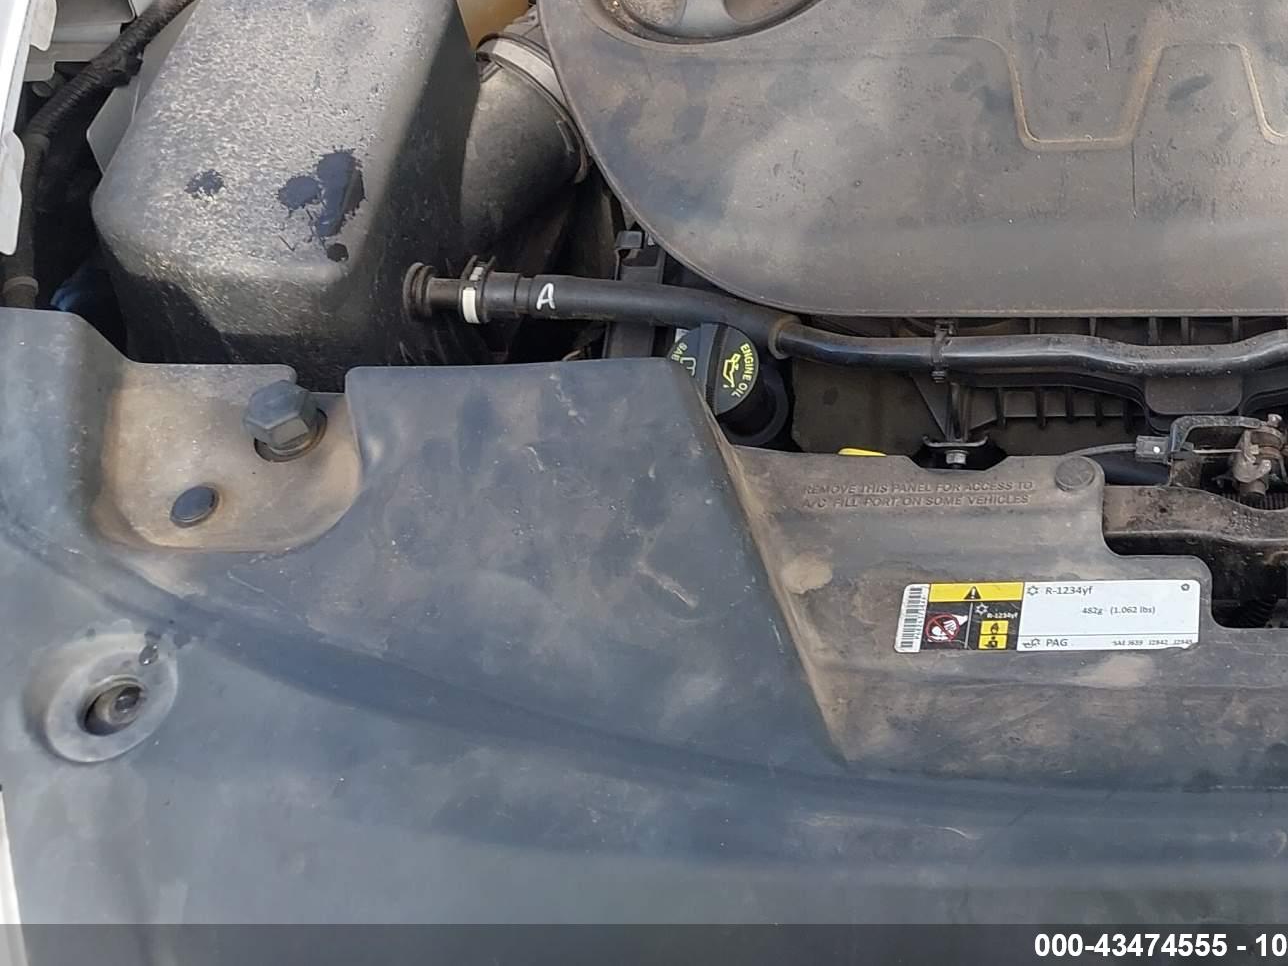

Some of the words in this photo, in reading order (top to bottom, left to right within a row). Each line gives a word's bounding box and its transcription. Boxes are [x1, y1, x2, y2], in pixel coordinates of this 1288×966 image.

[536, 282, 556, 310] A
[740, 343, 754, 381] ENGINE
[731, 382, 748, 398] OIL
[805, 484, 855, 495] REMOVE
[859, 484, 888, 494] THIS
[891, 483, 932, 494] PANEL
[936, 483, 961, 493] FOR
[965, 482, 1014, 492] ACCESS
[1016, 481, 1034, 492] TO
[804, 497, 828, 509] A/C
[835, 497, 857, 508] FILL
[865, 496, 899, 507] PORT
[903, 496, 922, 506] ON
[926, 495, 961, 506] SOME
[966, 494, 1030, 505] VEHICLES
[1045, 585, 1094, 597] R-1234yf
[1110, 606, 1138, 615] (1.062
[1139, 605, 1156, 615] lbs)
[1046, 639, 1069, 647] PAG
